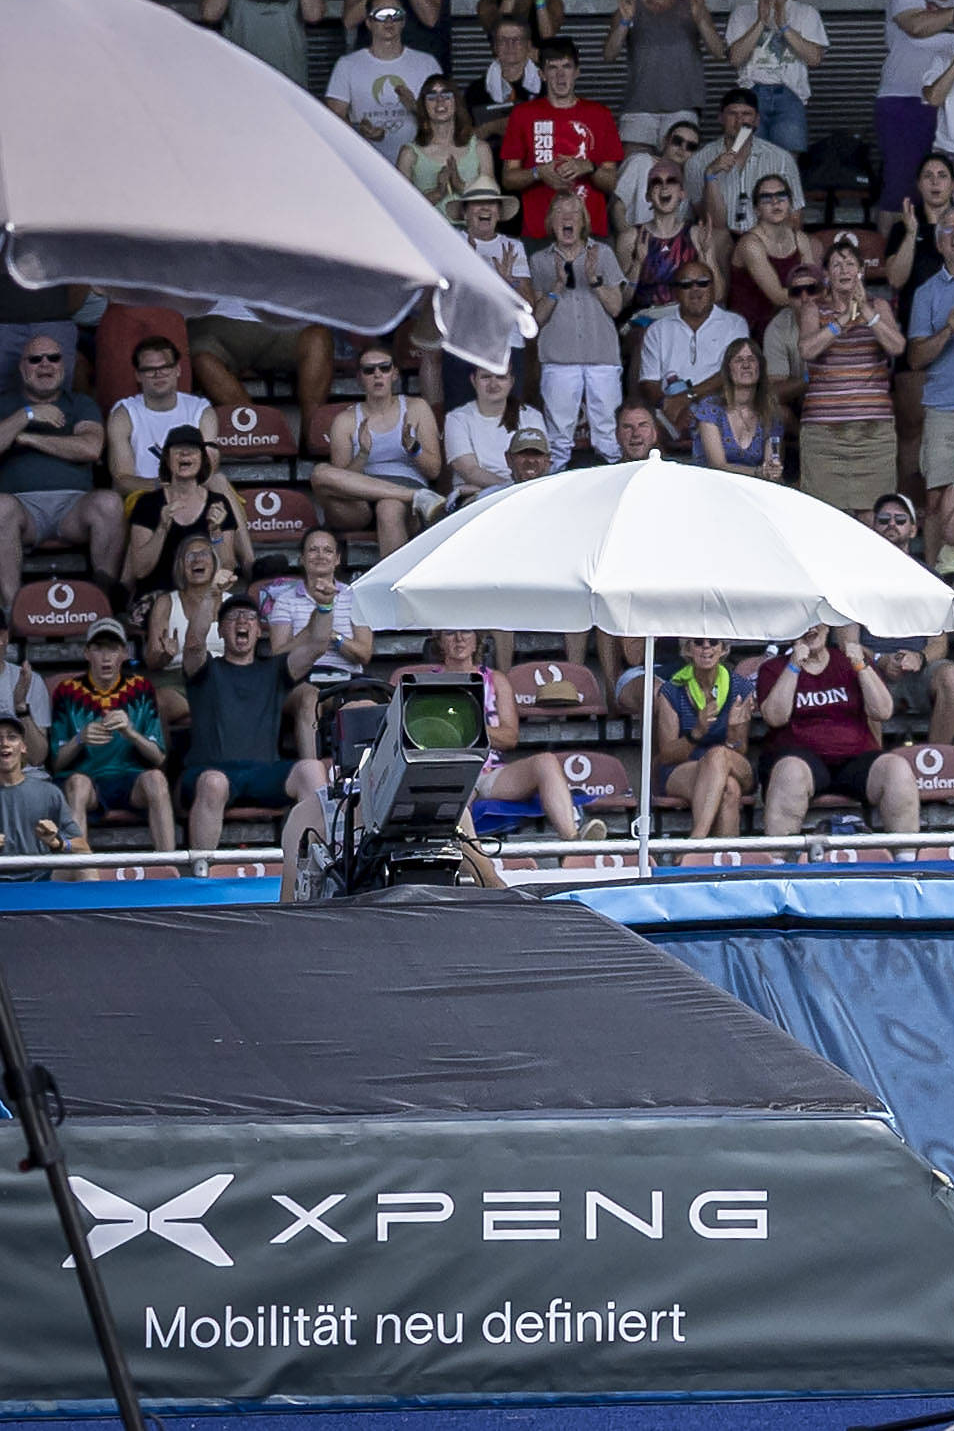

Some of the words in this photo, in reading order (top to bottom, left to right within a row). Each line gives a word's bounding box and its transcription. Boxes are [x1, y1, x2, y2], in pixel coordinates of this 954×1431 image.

[534, 136, 553, 148] 20
[28, 612, 98, 624] vodafone
[796, 687, 849, 708] MOIN
[270, 1190, 769, 1244] XPENG
[145, 1306, 357, 1349] Mobilität
[376, 1313, 465, 1345] neu
[482, 1298, 687, 1344] definiert
